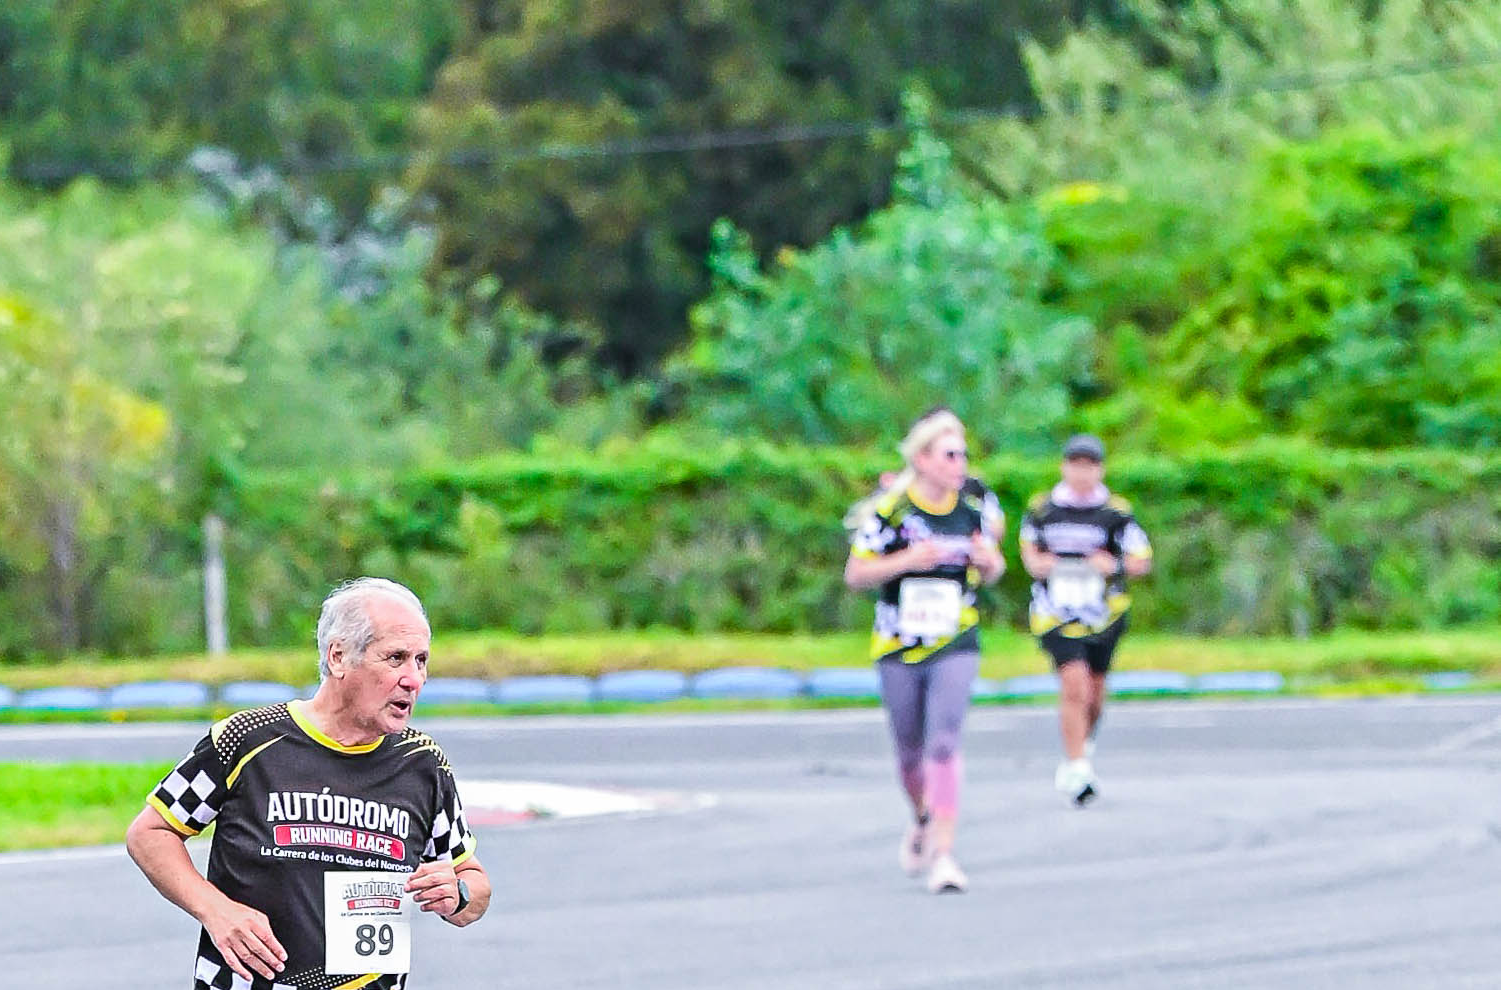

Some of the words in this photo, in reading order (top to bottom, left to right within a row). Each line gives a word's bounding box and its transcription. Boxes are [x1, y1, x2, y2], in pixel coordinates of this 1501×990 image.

[266, 787, 410, 839] AUTÓDROMO
[290, 827, 353, 847] RUNNING
[356, 832, 393, 855] RACE
[261, 846, 271, 855] La
[273, 847, 306, 859] Carrera
[308, 850, 319, 860] de
[321, 852, 334, 862] los
[336, 854, 363, 867] Clubes
[365, 858, 378, 868] del
[355, 924, 394, 956] 89
